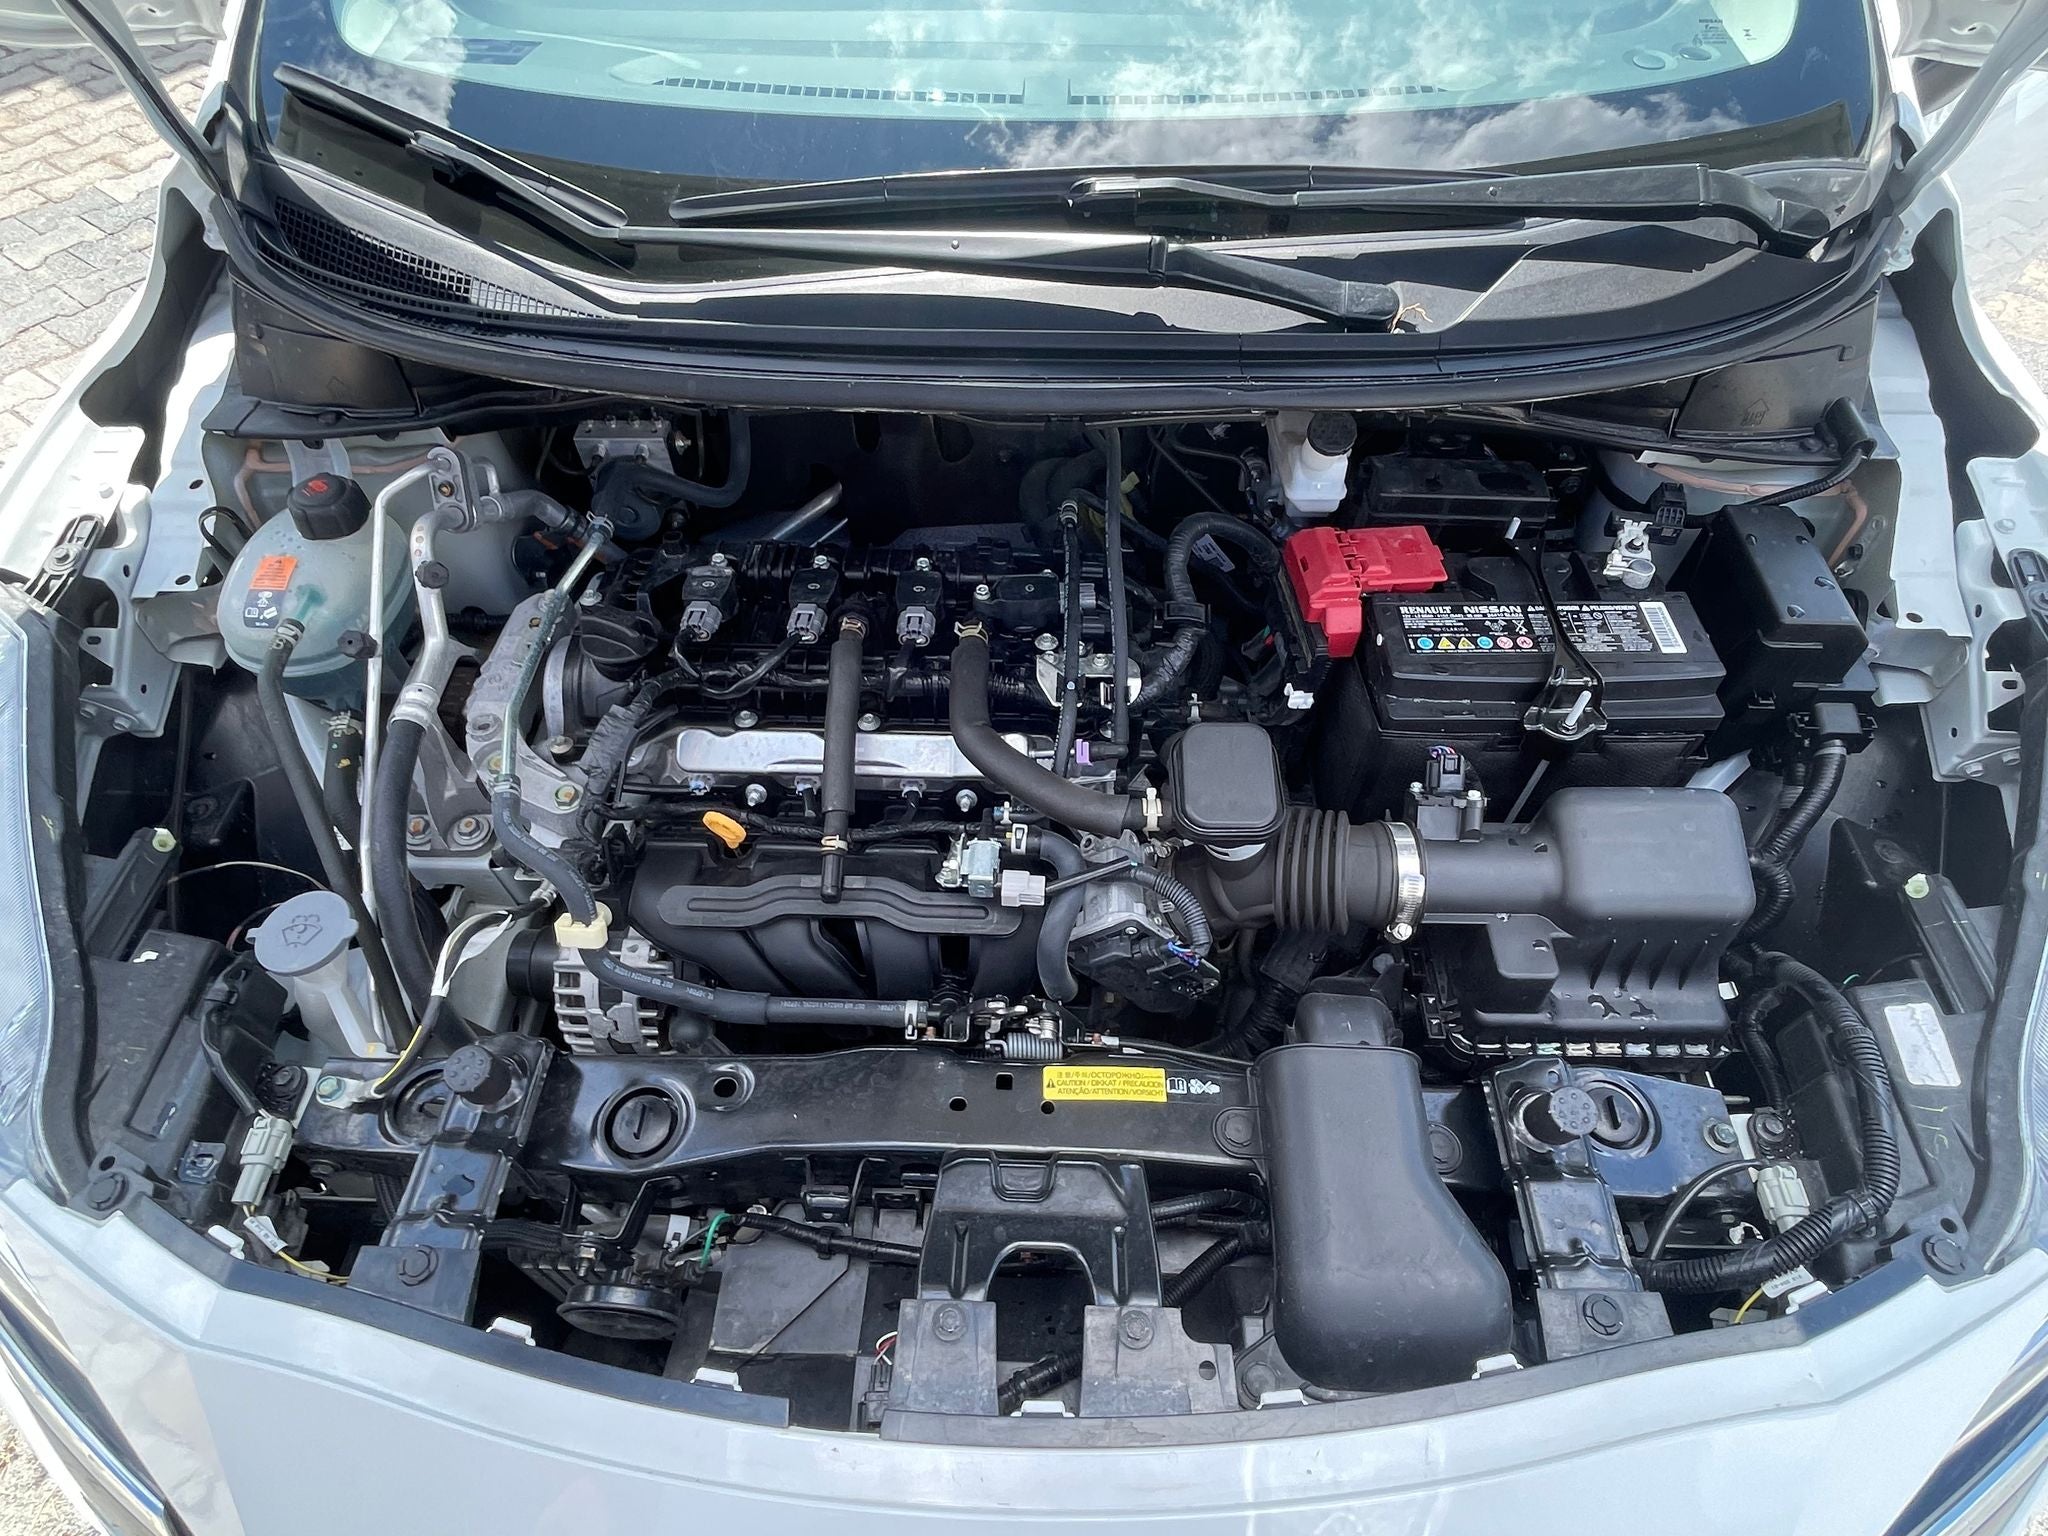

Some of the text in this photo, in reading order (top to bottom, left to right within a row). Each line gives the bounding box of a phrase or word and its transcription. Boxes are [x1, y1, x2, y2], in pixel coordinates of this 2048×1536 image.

[1399, 605, 1522, 614] RENAULT NISSAN
[1056, 1079, 1086, 1087] CAUTION
